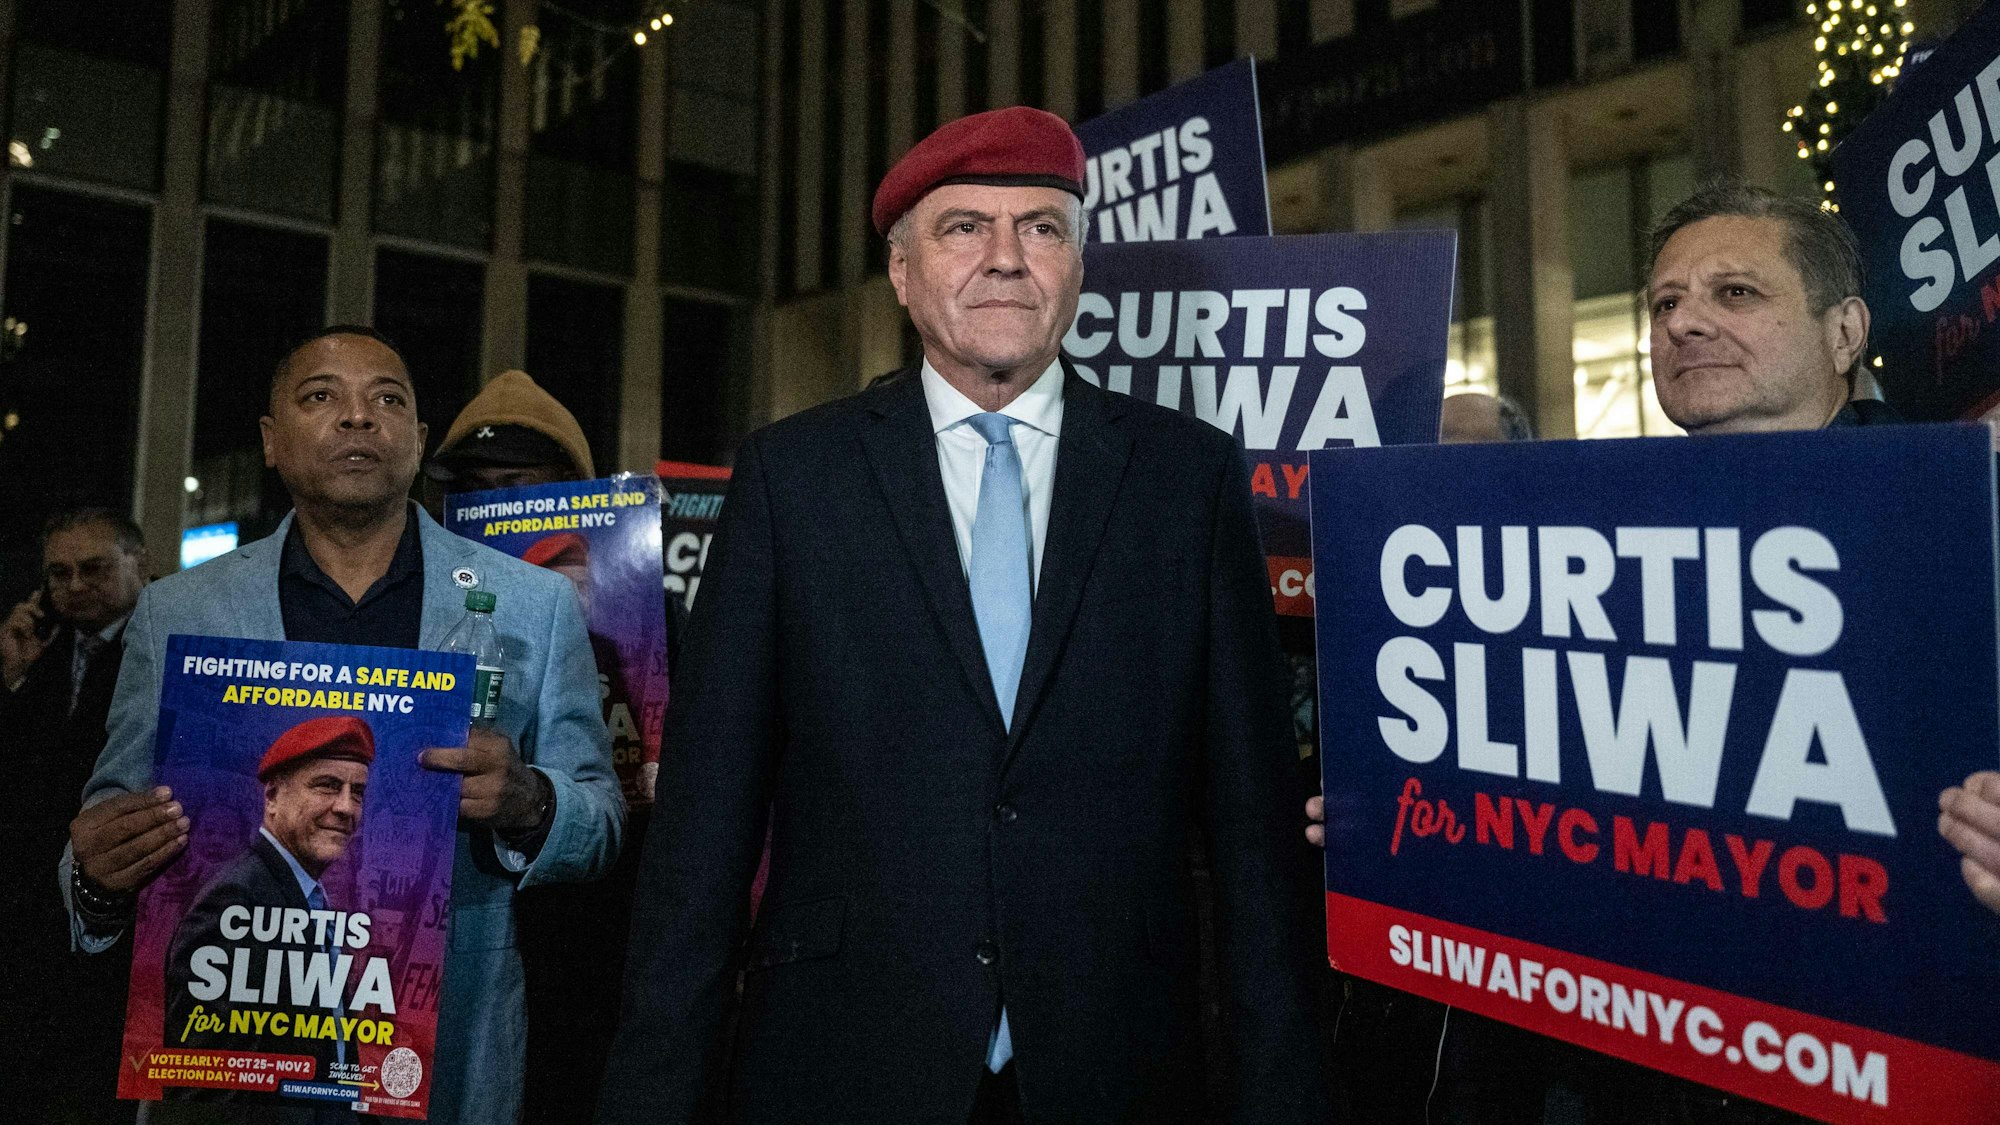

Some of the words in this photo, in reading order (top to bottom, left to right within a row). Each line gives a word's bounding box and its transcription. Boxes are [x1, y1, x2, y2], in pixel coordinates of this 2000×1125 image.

[1061, 286, 1368, 359] CURTIS
[1074, 364, 1382, 451] IWA
[456, 501, 524, 522] FIGHTING
[525, 498, 555, 515] FOR
[557, 497, 570, 512] A
[571, 494, 609, 510] SAFE
[611, 492, 646, 507] AND
[668, 493, 726, 519] FIGHT
[484, 515, 580, 537] AFFORDABLE
[581, 512, 616, 528] NYC
[1379, 523, 1844, 657] CURTIS
[183, 655, 288, 680] FIGHTING
[289, 662, 333, 683] FOR
[335, 666, 353, 684] A
[356, 666, 410, 688] SAFE
[411, 671, 456, 691] AND
[222, 684, 366, 711] AFFORDABLE
[367, 693, 415, 714] NYC
[1375, 636, 1898, 837] SLIWA
[1390, 776, 1465, 856] for
[1474, 791, 1600, 864] NYC
[1613, 815, 1889, 924] MAYOR
[219, 904, 372, 949] CURTIS
[188, 945, 396, 1014] SLIWA
[180, 1004, 225, 1042] for
[229, 1009, 290, 1036] NYC
[293, 1013, 395, 1046] MAYOR
[1389, 924, 1891, 1108] SLIWAFORNYC.COM
[148, 1068, 205, 1081] ELECTION
[206, 1070, 235, 1082] DAY:
[238, 1073, 267, 1084] NOV
[266, 1074, 274, 1085] 4
[150, 1054, 184, 1066] VOTE
[184, 1055, 225, 1068] EARLY:
[227, 1057, 253, 1069] OCT
[276, 1060, 302, 1072] NOV
[303, 1061, 311, 1073] 2
[328, 1070, 366, 1081] INVOLVED!
[329, 1062, 350, 1071] SCAN
[350, 1063, 360, 1072] TO
[361, 1065, 378, 1074] GET
[283, 1084, 359, 1098] SLIWAFORNYC.COM
